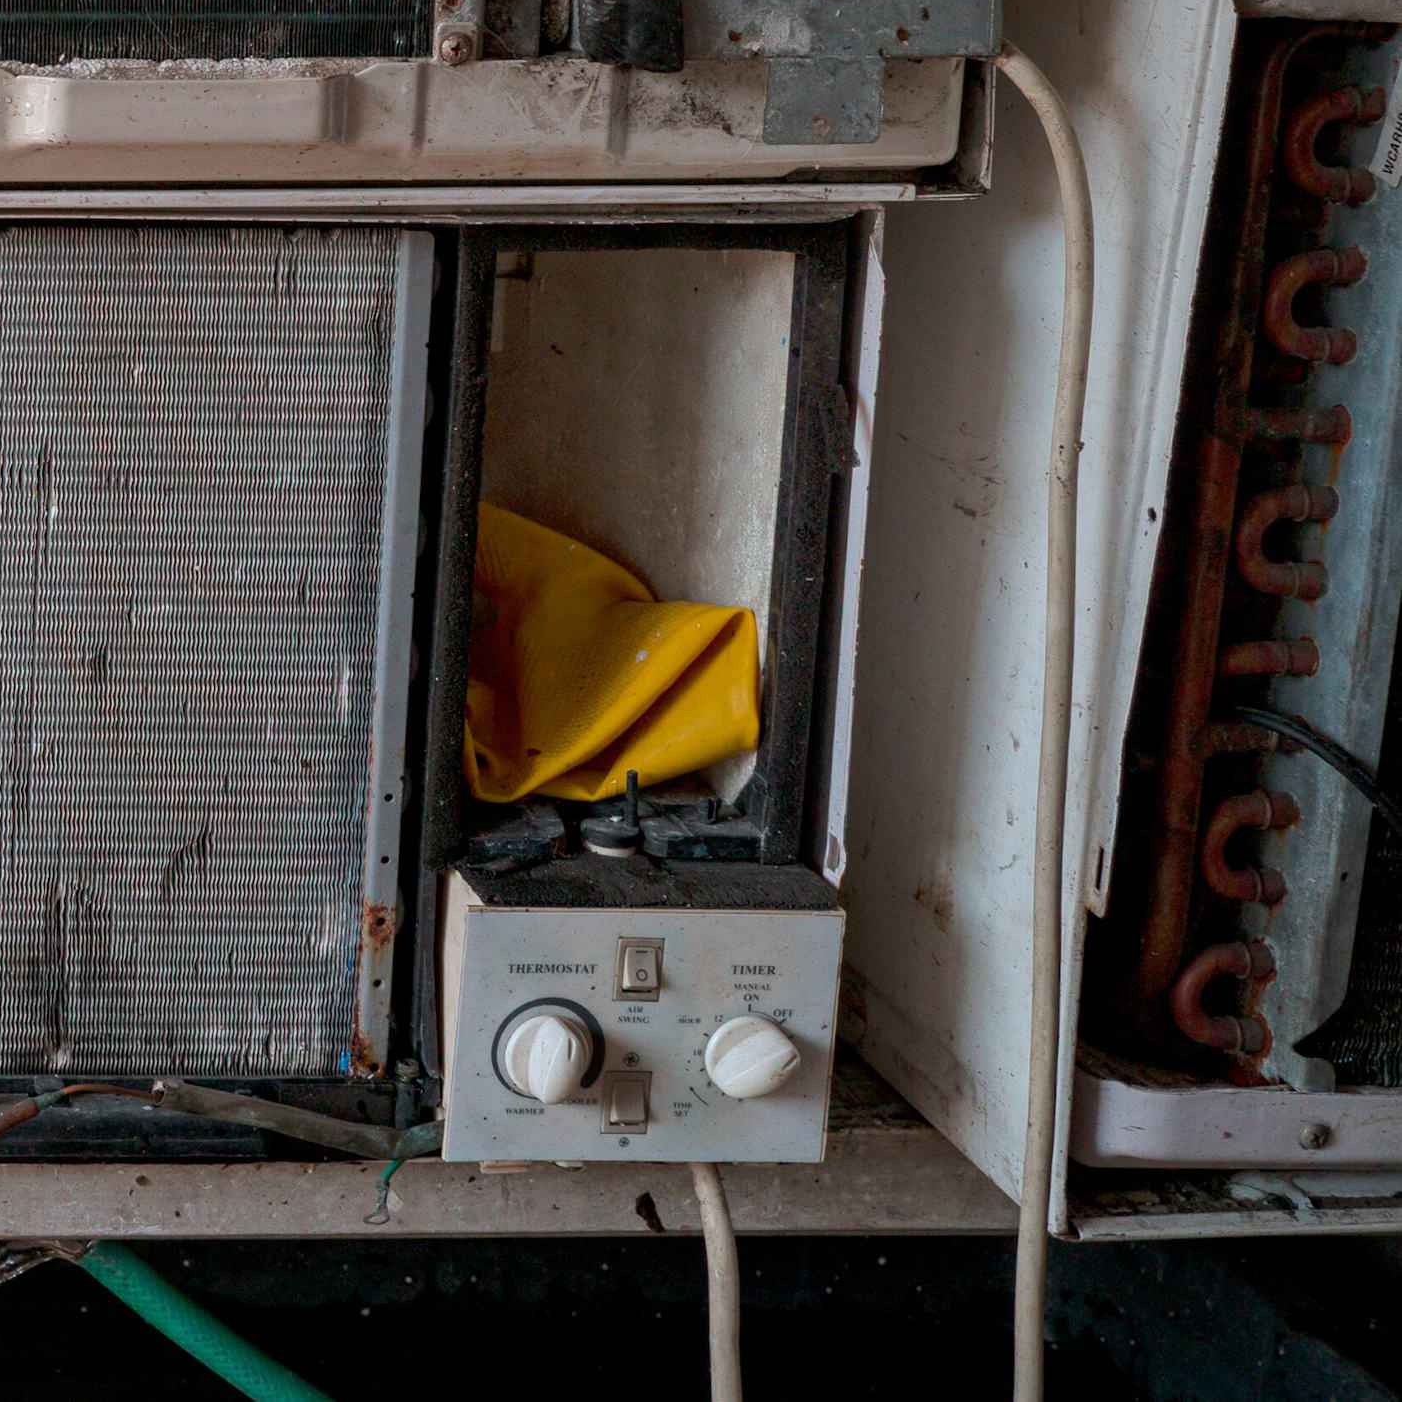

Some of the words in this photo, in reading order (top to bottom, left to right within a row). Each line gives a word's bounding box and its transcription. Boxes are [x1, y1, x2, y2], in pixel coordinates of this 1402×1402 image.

[507, 963, 598, 975] THERMOSTAT
[731, 964, 776, 976] TIMER
[734, 983, 772, 991] MANUAL
[743, 993, 760, 1003] ON
[773, 1008, 796, 1018] OFF
[617, 1016, 650, 1024] SWING
[714, 1014, 724, 1023] 12
[562, 1098, 598, 1106] OOLER
[505, 1107, 546, 1116] WARMER
